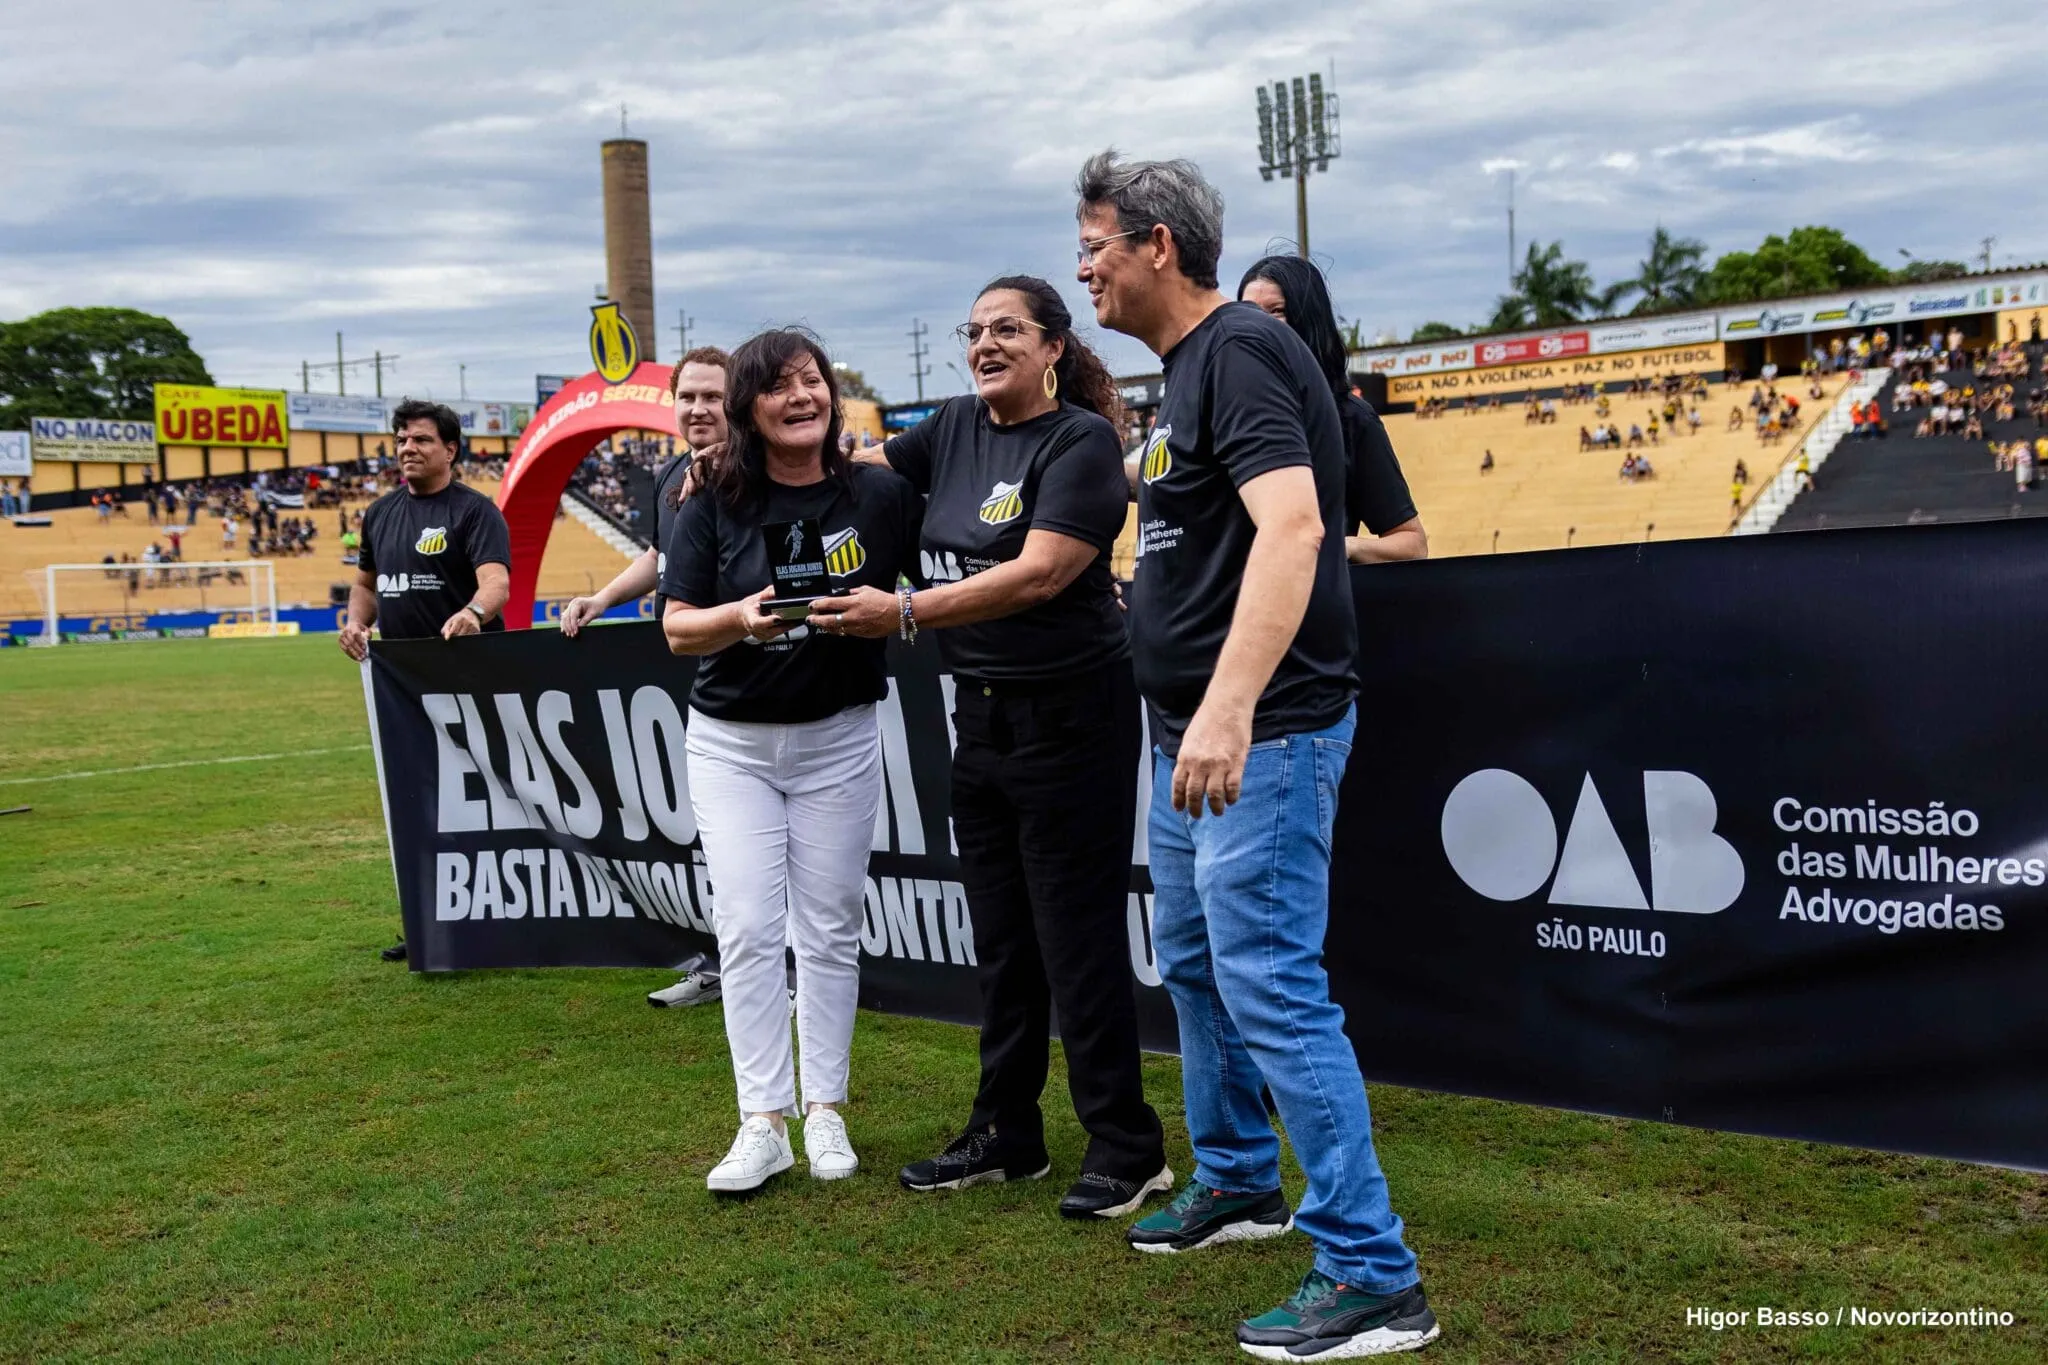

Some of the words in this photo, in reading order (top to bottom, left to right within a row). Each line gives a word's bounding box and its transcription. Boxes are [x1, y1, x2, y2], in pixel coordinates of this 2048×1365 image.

[1394, 382, 1424, 393] DIGA
[1432, 374, 1459, 389] NÃO
[1479, 365, 1554, 384] VIOLÊNCIA
[1574, 360, 1605, 374] PAZ
[1613, 357, 1634, 371] NO
[1642, 348, 1716, 367] FUTEBOL
[35, 420, 153, 443] NO-MACON
[161, 400, 284, 443] ÚBEDA
[920, 549, 963, 580] OAB
[421, 689, 602, 840] ELAS
[1773, 797, 1979, 836] Comissão
[1441, 768, 1745, 914] OAB
[436, 848, 580, 921] BASTA
[573, 851, 635, 918] DE
[1777, 842, 1847, 877] das
[1856, 845, 2046, 885] Mulheres
[1779, 886, 2005, 934] Advogadas
[1536, 917, 1583, 949] SÃO
[1589, 924, 1666, 958] PAULO
